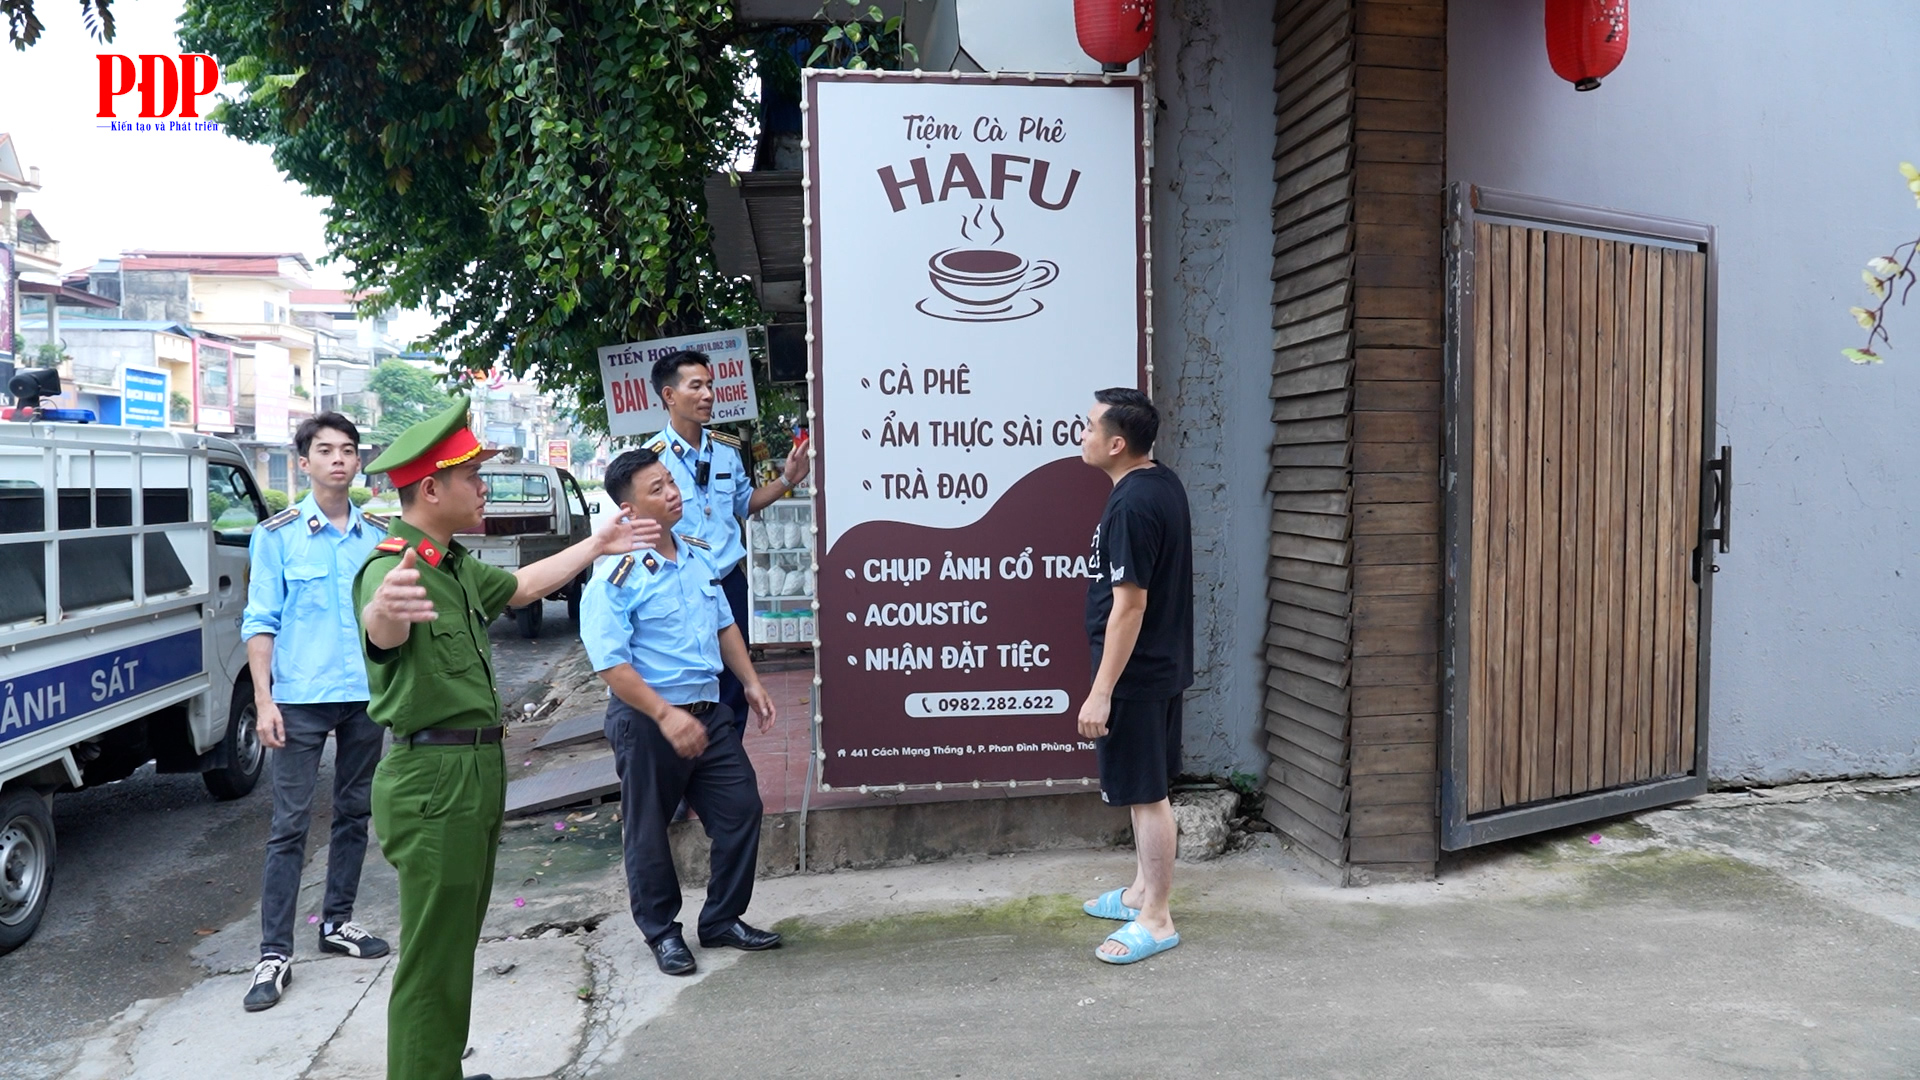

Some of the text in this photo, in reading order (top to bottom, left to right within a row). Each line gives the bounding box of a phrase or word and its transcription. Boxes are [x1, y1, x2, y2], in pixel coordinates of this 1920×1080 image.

[902, 114, 1067, 149] Tiệm Cà Phê
[876, 152, 1082, 213] HAFU
[607, 346, 644, 367] TIẾN
[719, 358, 744, 380] DÂY
[611, 372, 649, 414] BÁN
[715, 381, 748, 404] NGHỆ
[879, 363, 971, 395] CÀ PHÊ
[718, 404, 747, 419] CHẤT
[880, 410, 919, 447] ẨM
[929, 417, 994, 453] THỰC
[1052, 414, 1083, 447] GÒ
[881, 467, 988, 505] TRÀ ĐẠO
[863, 556, 931, 586] CHỤP
[940, 551, 990, 581] ẢNH
[999, 547, 1034, 580] CỔ
[1042, 555, 1089, 579] TRA
[865, 642, 933, 675] NHẬN
[940, 641, 988, 673] ĐẶT
[91, 656, 139, 702] SÁT
[938, 696, 1054, 712] 0982.282.622
[850, 748, 868, 757] 441
[871, 747, 899, 757] Cách
[901, 747, 931, 757] Mạng
[933, 745, 964, 756] Tháng
[966, 745, 976, 754] 8,
[978, 745, 986, 753] P.
[989, 744, 1014, 753] Phan
[1016, 742, 1039, 752] Đình
[1041, 742, 1075, 753] Phùng,
